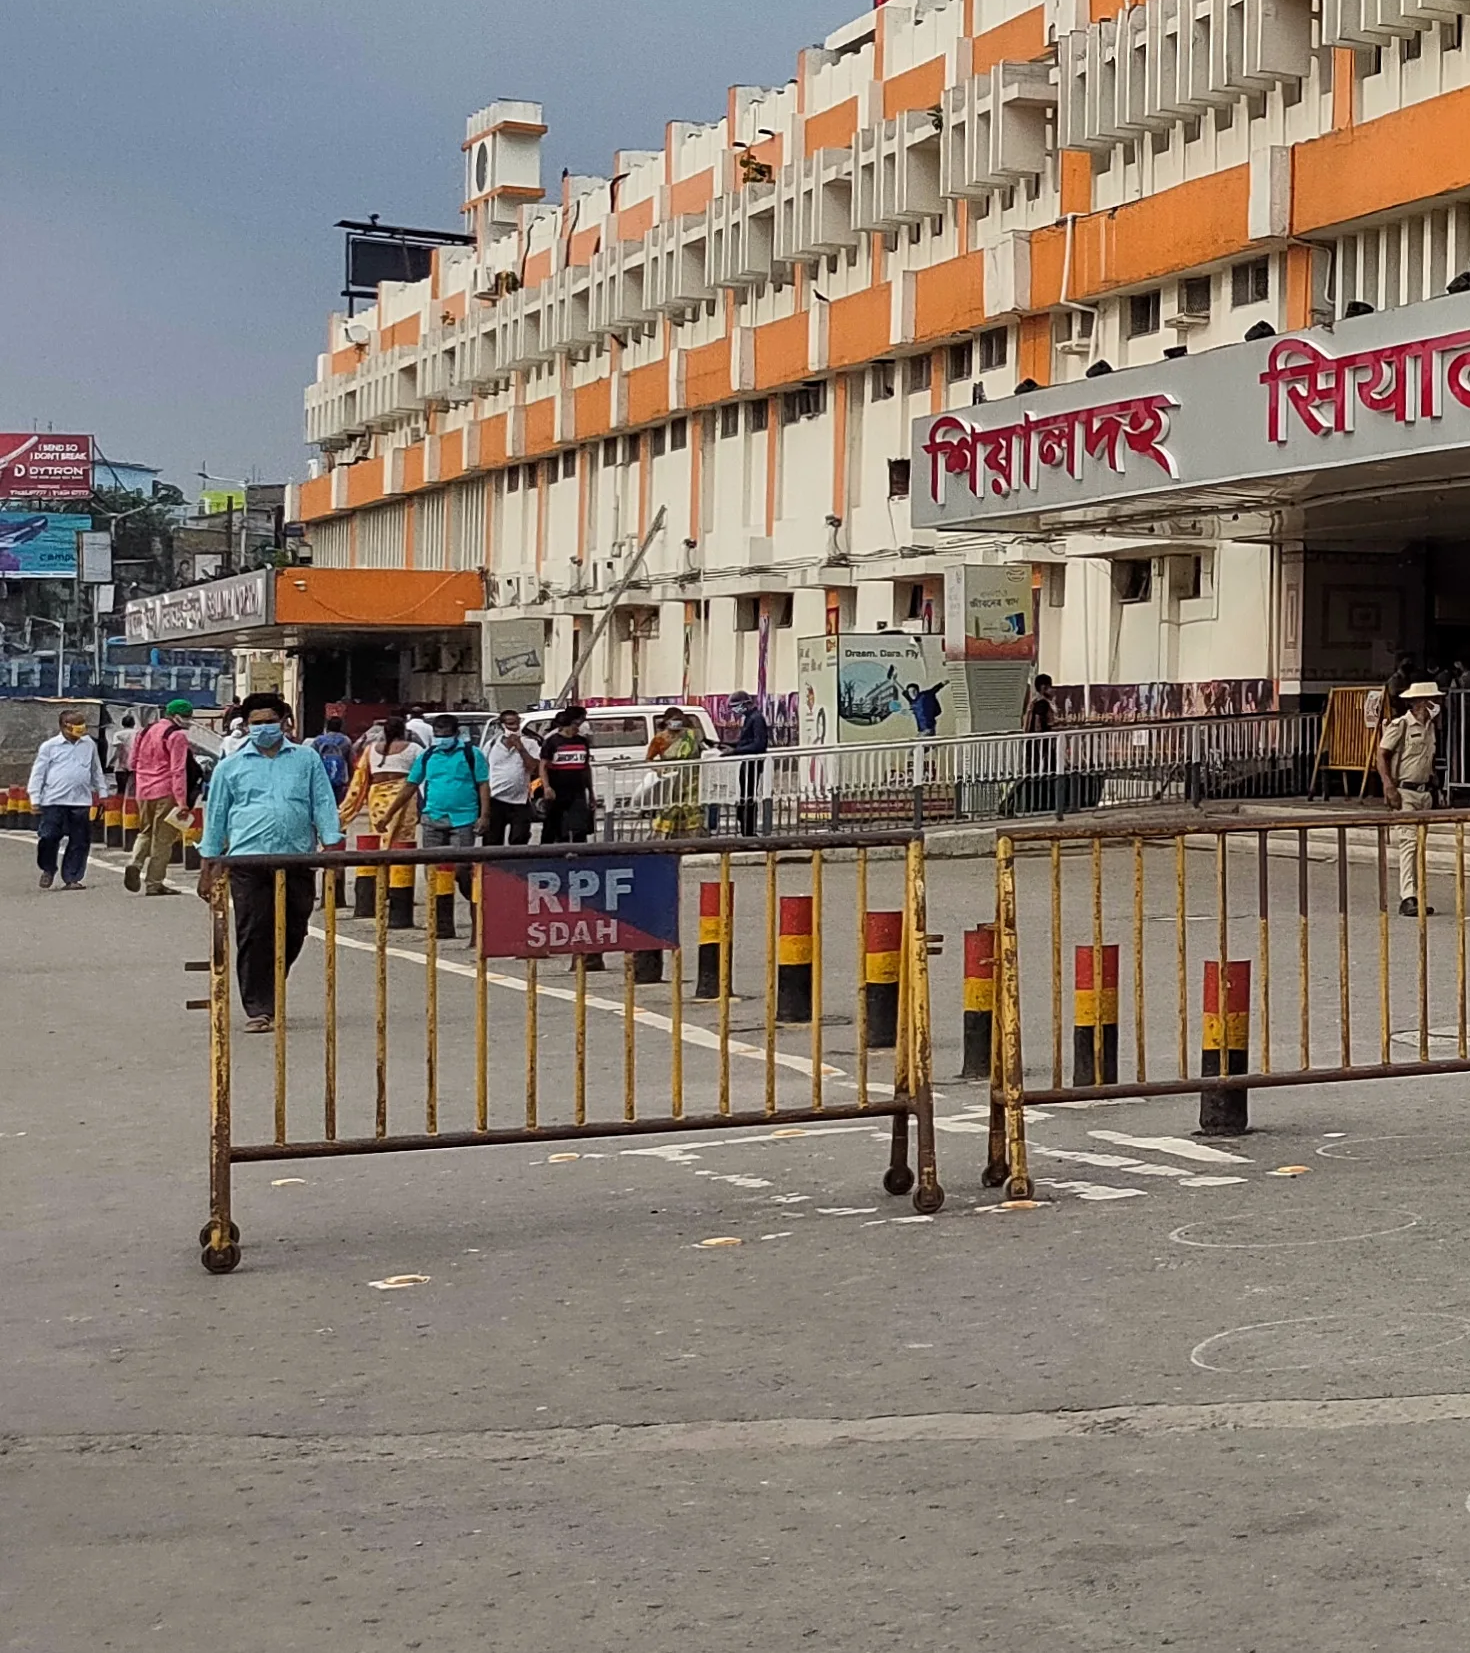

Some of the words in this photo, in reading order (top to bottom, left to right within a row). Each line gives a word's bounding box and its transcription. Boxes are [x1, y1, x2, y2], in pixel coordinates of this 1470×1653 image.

[61, 452, 87, 461] BREAK
[922, 393, 1182, 505] শিয়ালদহ
[29, 466, 83, 475] DYTRON
[527, 868, 634, 914] RPF
[527, 919, 618, 947] SDAH
